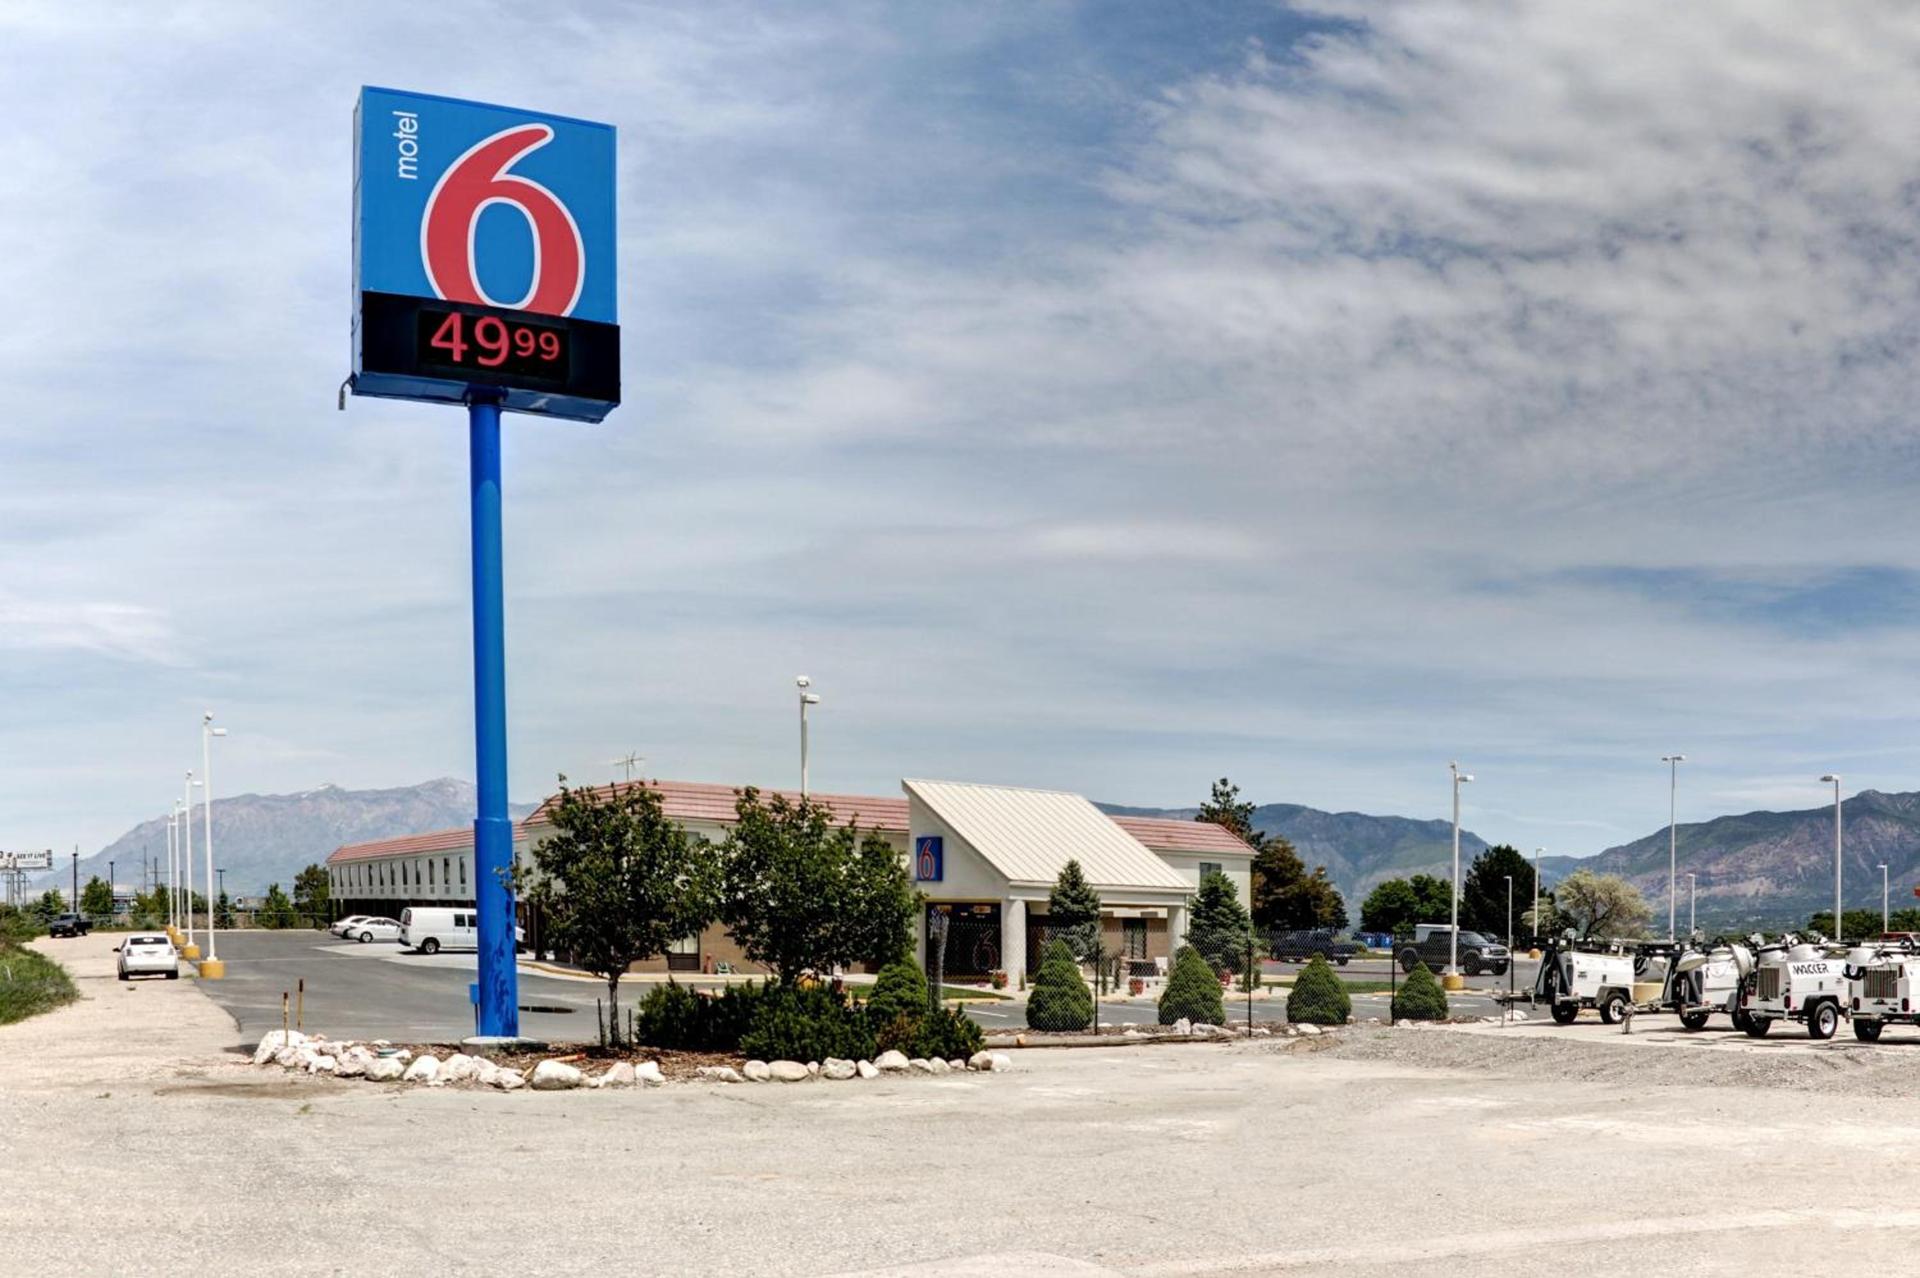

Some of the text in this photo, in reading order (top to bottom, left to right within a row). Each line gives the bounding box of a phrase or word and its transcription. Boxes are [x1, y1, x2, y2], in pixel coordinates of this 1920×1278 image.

[392, 110, 418, 180] motel
[420, 122, 586, 317] 6
[918, 839, 935, 880] 6
